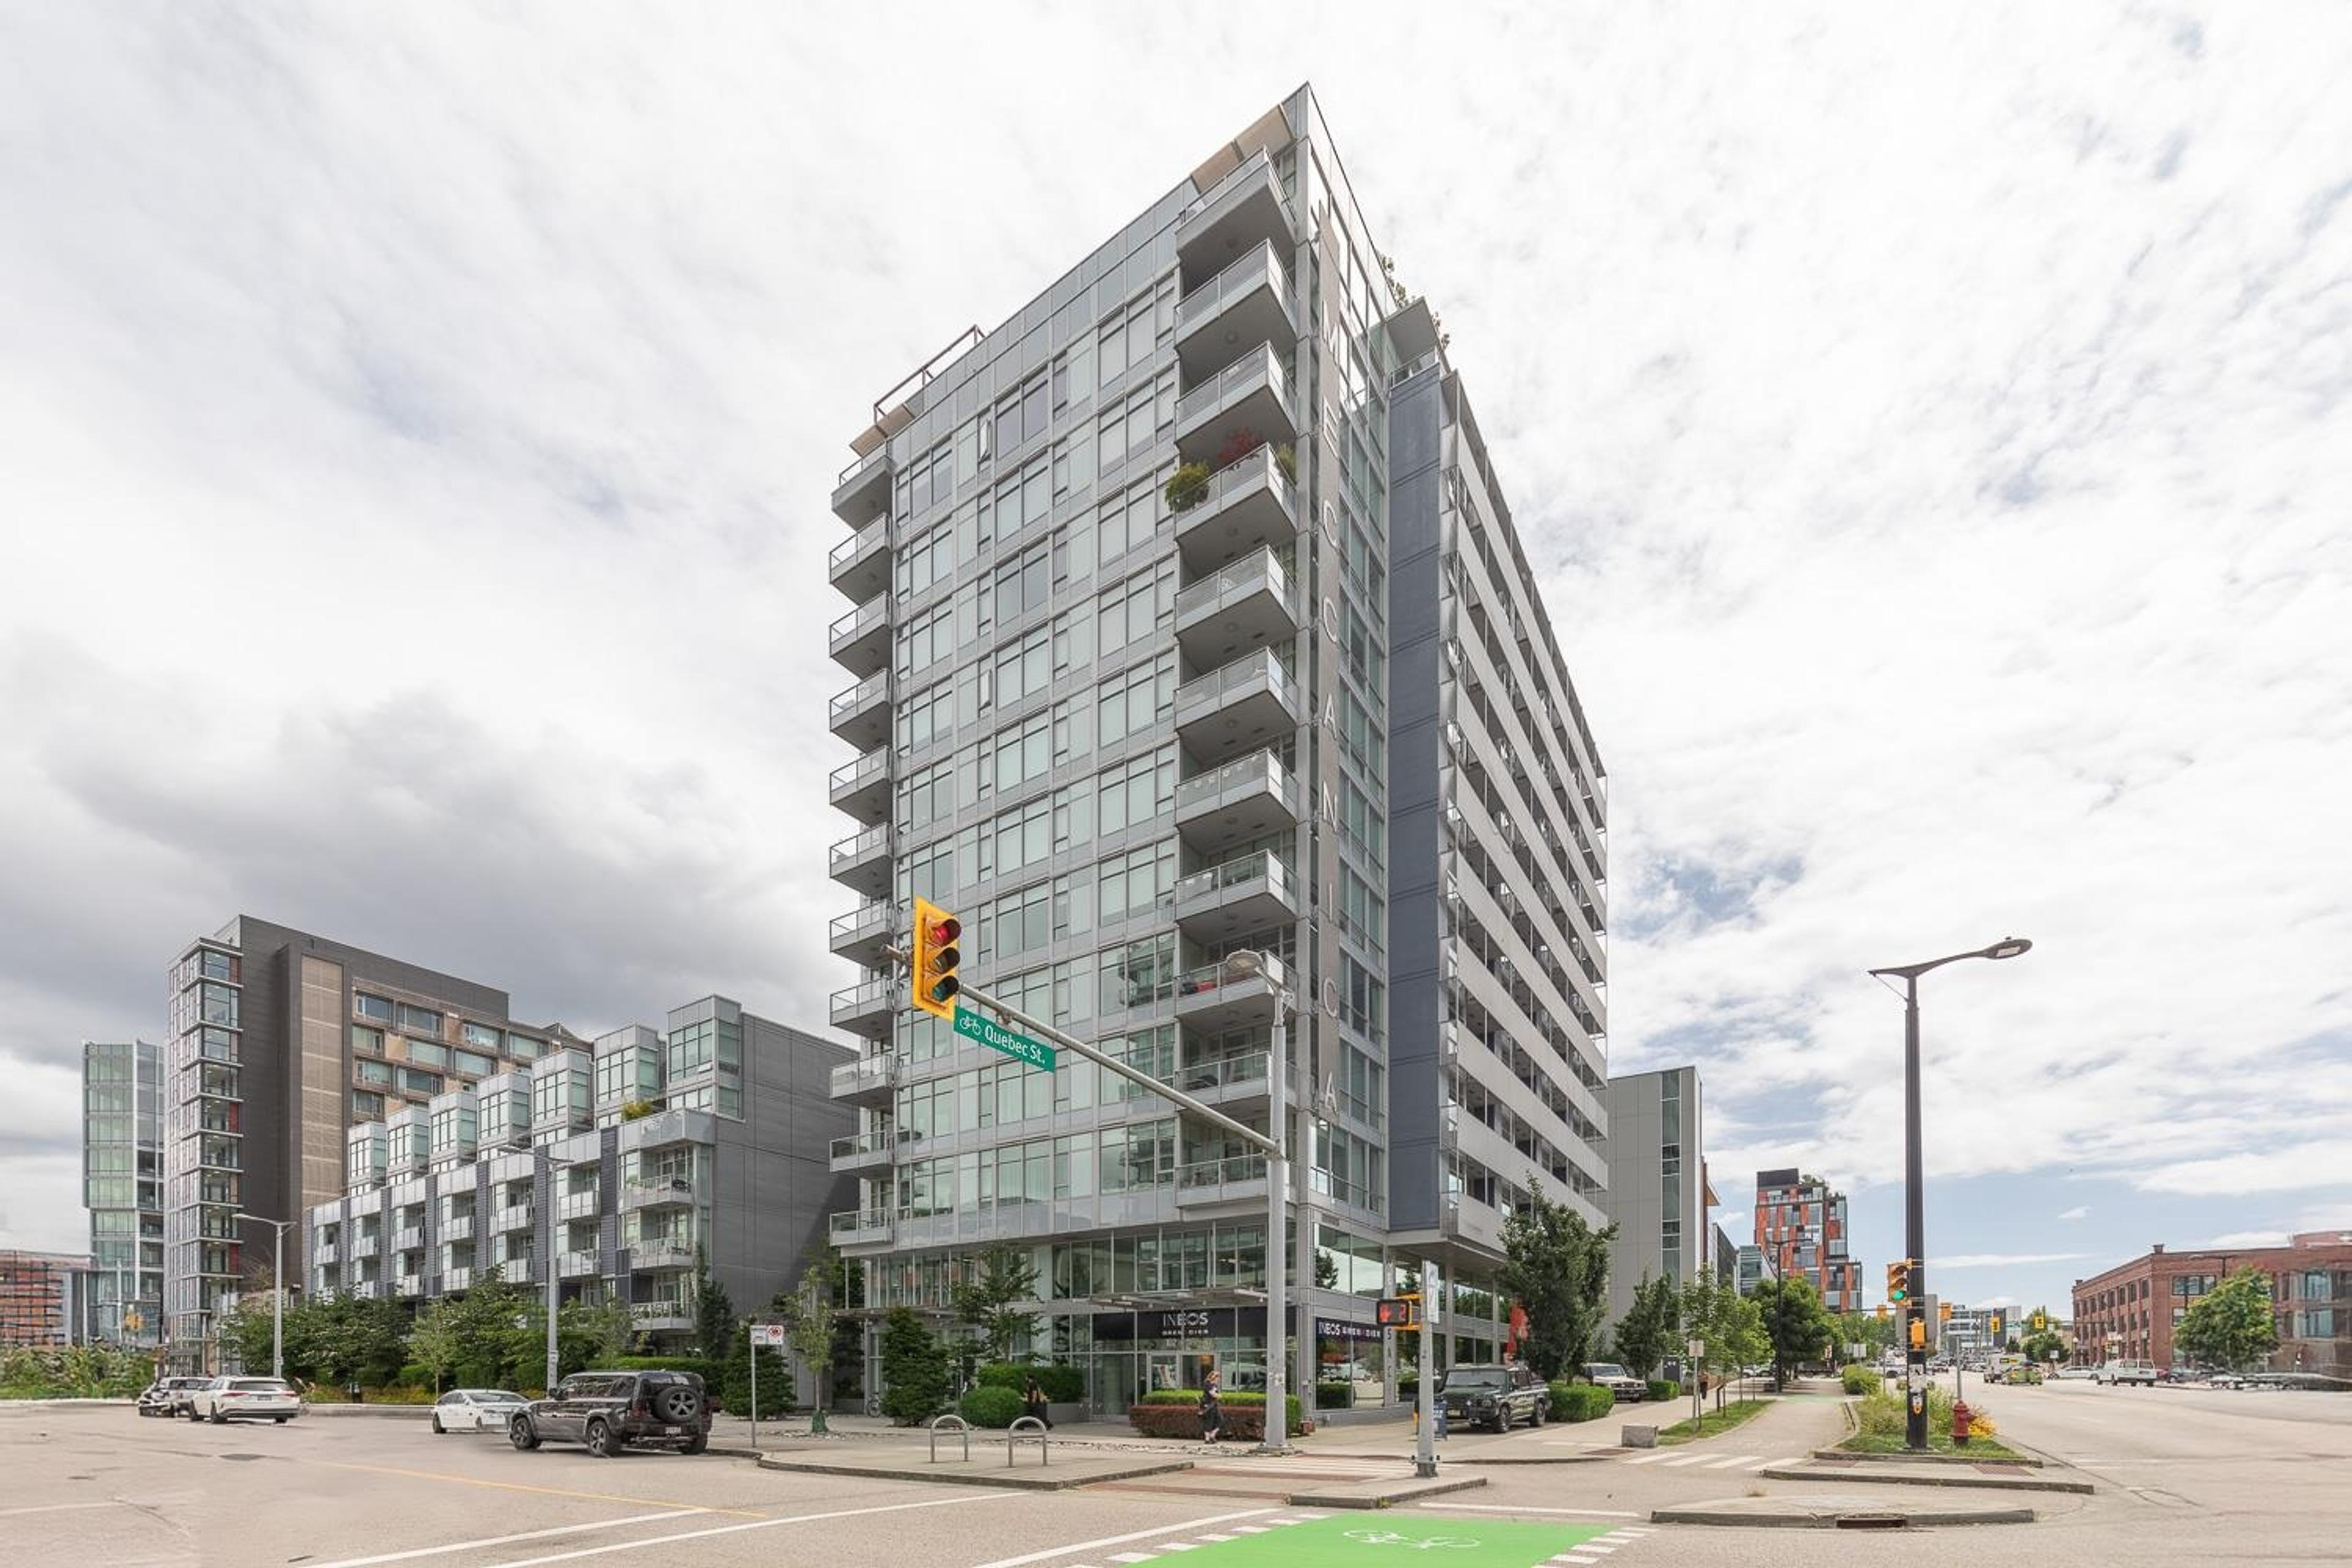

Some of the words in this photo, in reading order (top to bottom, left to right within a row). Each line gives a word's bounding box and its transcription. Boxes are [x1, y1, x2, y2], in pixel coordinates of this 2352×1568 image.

[1323, 300, 1339, 1115] MECCANICA
[984, 1024, 1028, 1057] Quebec
[1030, 1044, 1046, 1064] St.
[1163, 1312, 1208, 1327] INEOS
[1318, 1322, 1341, 1335] INEOS
